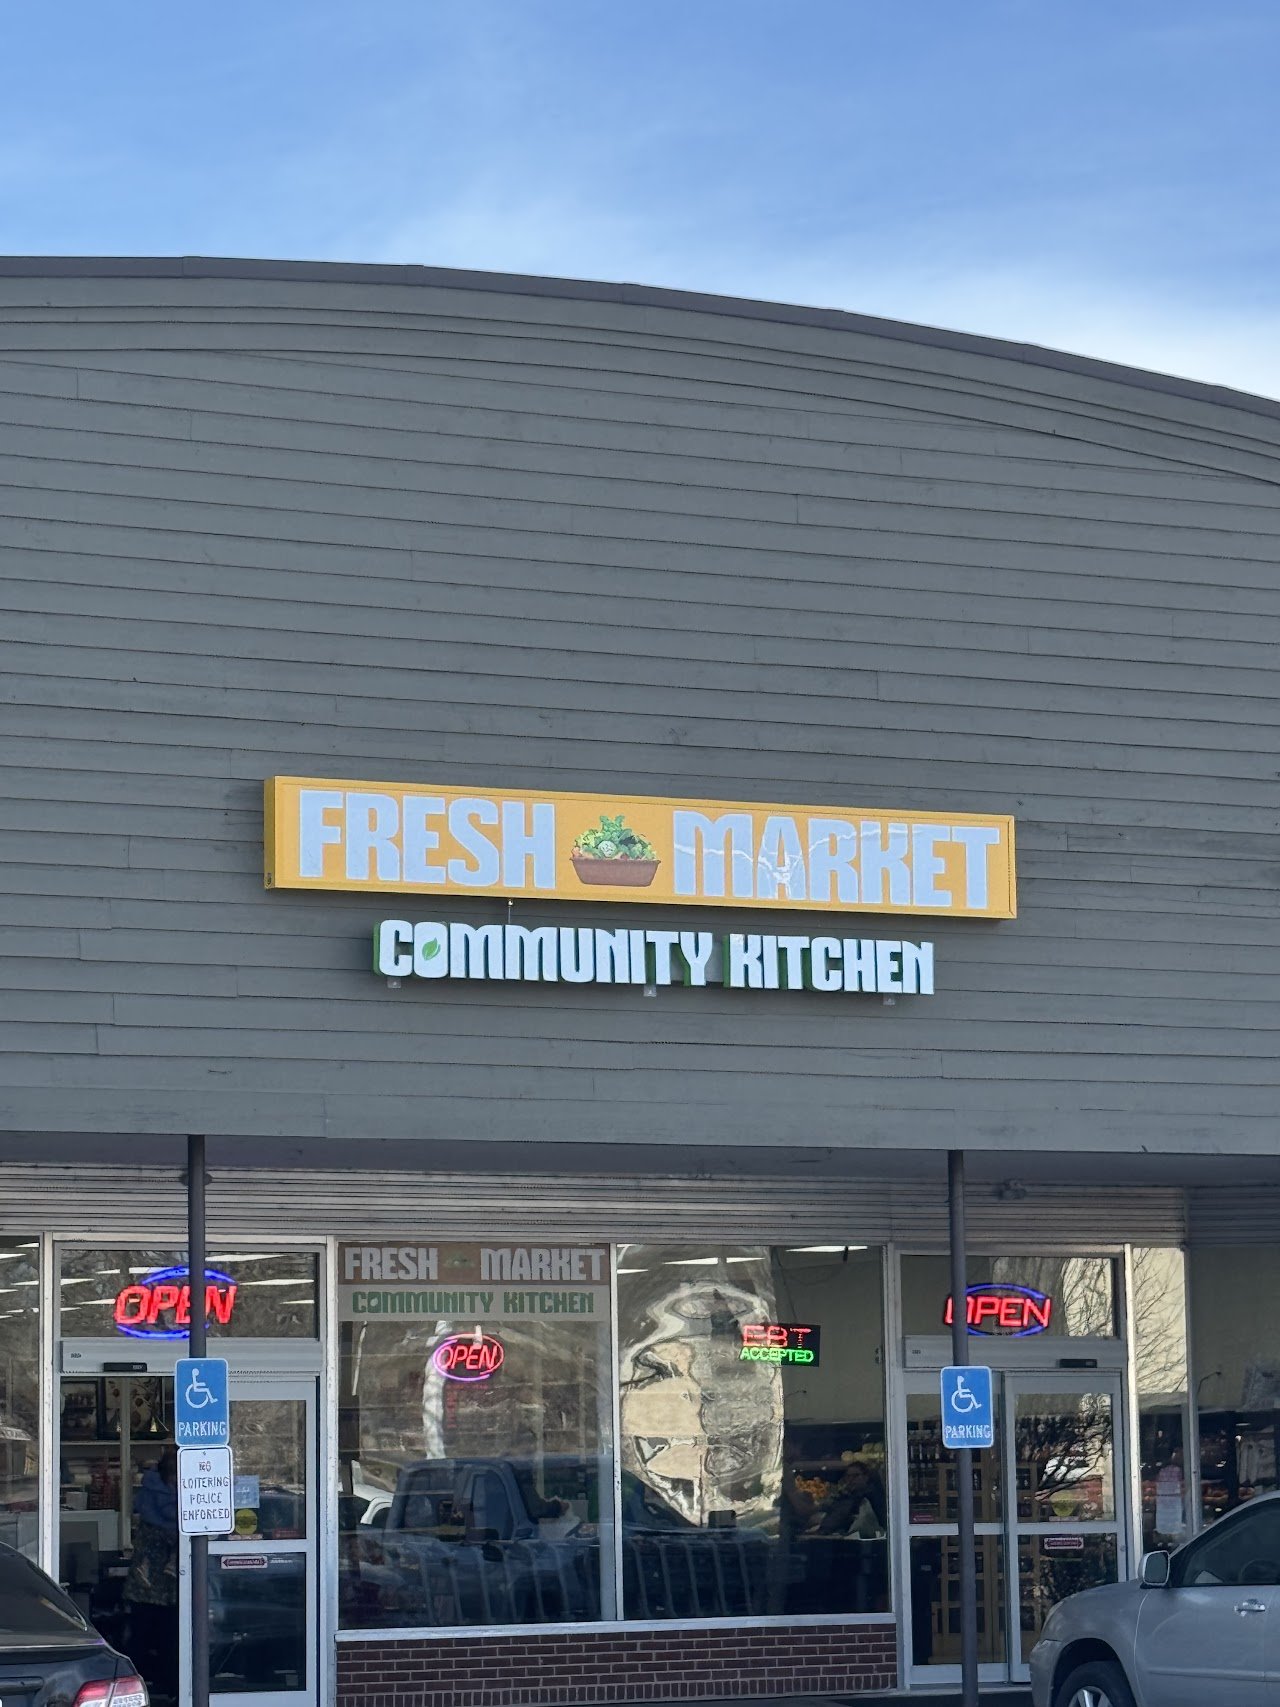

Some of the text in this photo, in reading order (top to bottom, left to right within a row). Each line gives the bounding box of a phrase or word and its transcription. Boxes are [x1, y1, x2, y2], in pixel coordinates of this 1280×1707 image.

[299, 789, 1000, 910] FRESH MARKET
[377, 919, 935, 995] COMMUNITY KITCHEN
[344, 1247, 605, 1281] FRESH MARKET
[352, 1290, 594, 1314] COMMUNITY KITCHEN
[742, 1325, 812, 1348] EBT
[436, 1345, 497, 1370] OPEN
[740, 1346, 814, 1363] ACCEPTED
[178, 1421, 227, 1437] PARKING
[945, 1424, 991, 1439] PARKING
[182, 1476, 230, 1489] LOITERING
[190, 1493, 223, 1505] POLICE
[182, 1508, 230, 1520] ENFORCED
